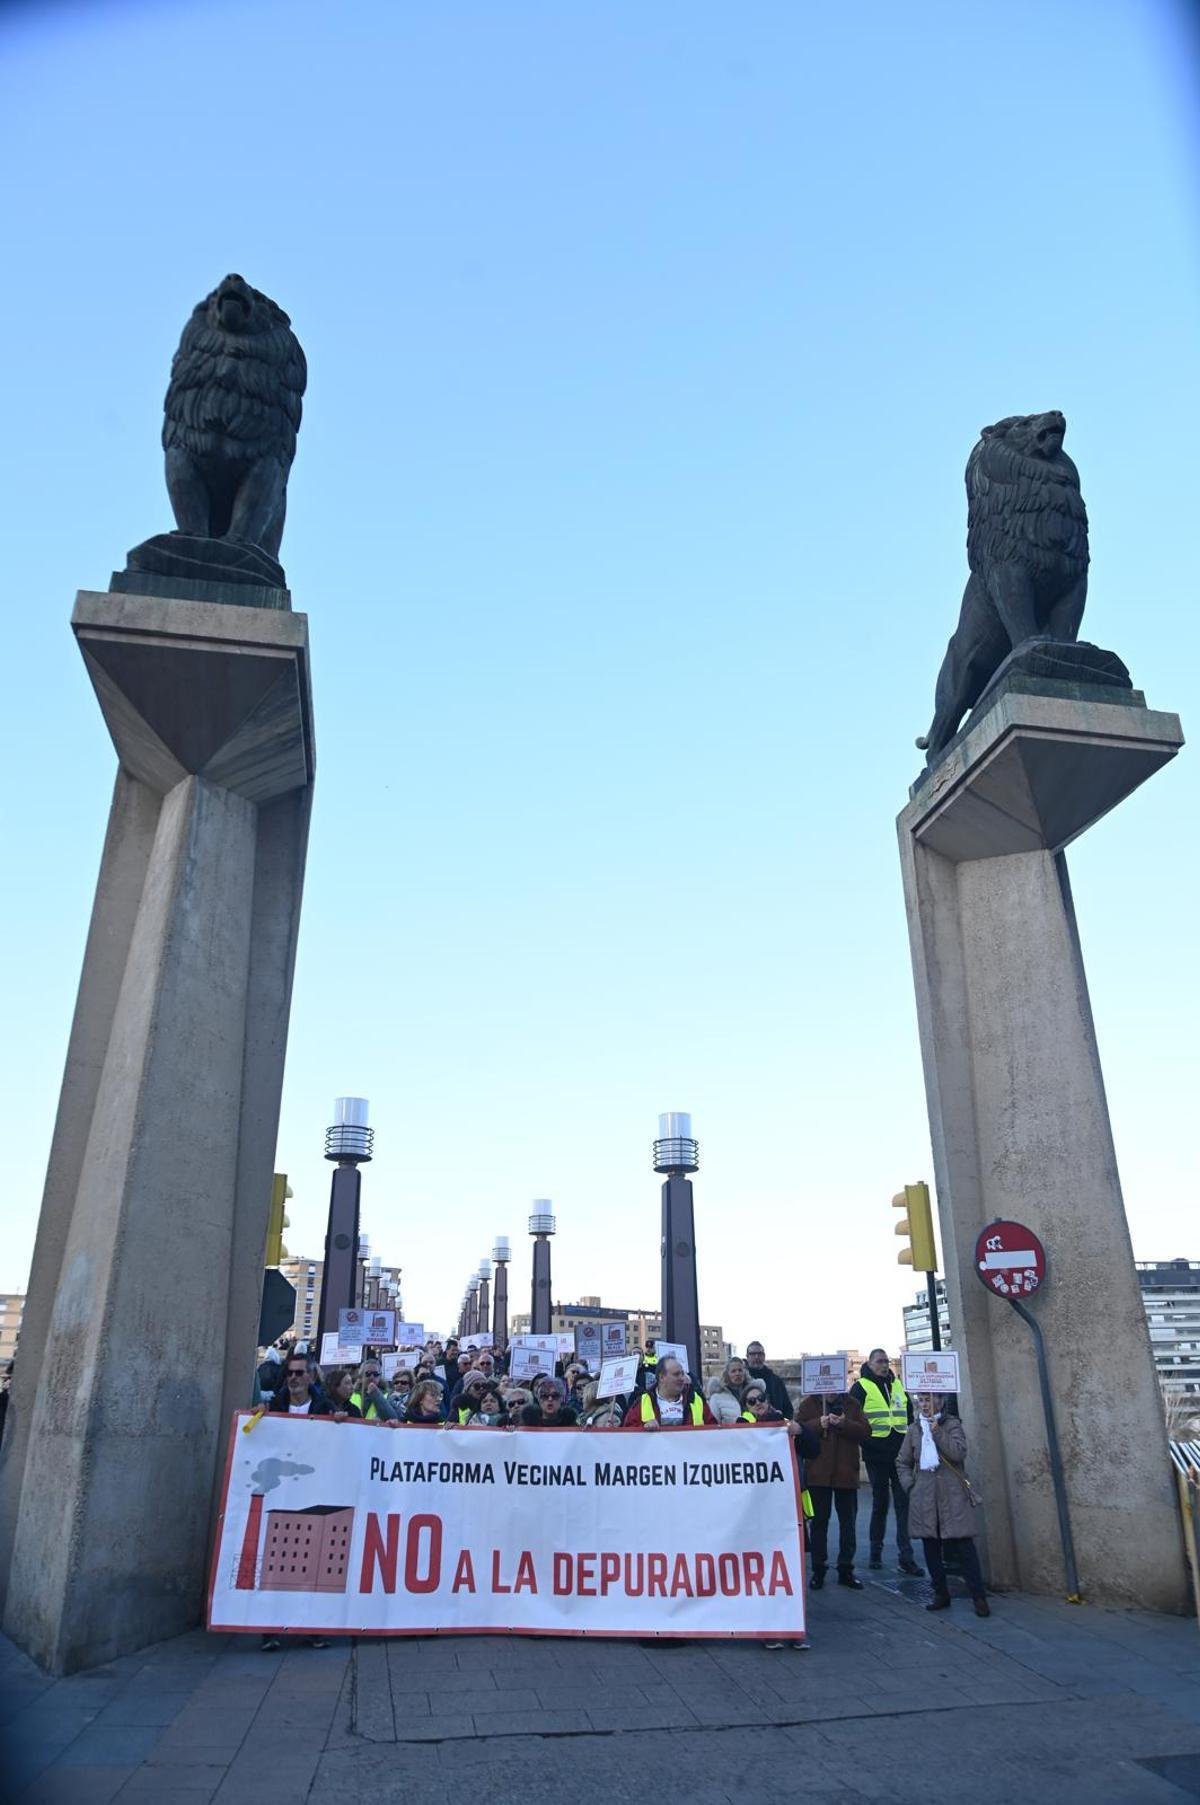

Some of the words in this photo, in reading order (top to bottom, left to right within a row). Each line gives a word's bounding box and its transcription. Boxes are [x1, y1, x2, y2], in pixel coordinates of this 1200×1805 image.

[359, 1512, 443, 1594] NO
[452, 1549, 476, 1593] A
[491, 1550, 538, 1594] LA
[553, 1550, 793, 1597] DEPURADORA
